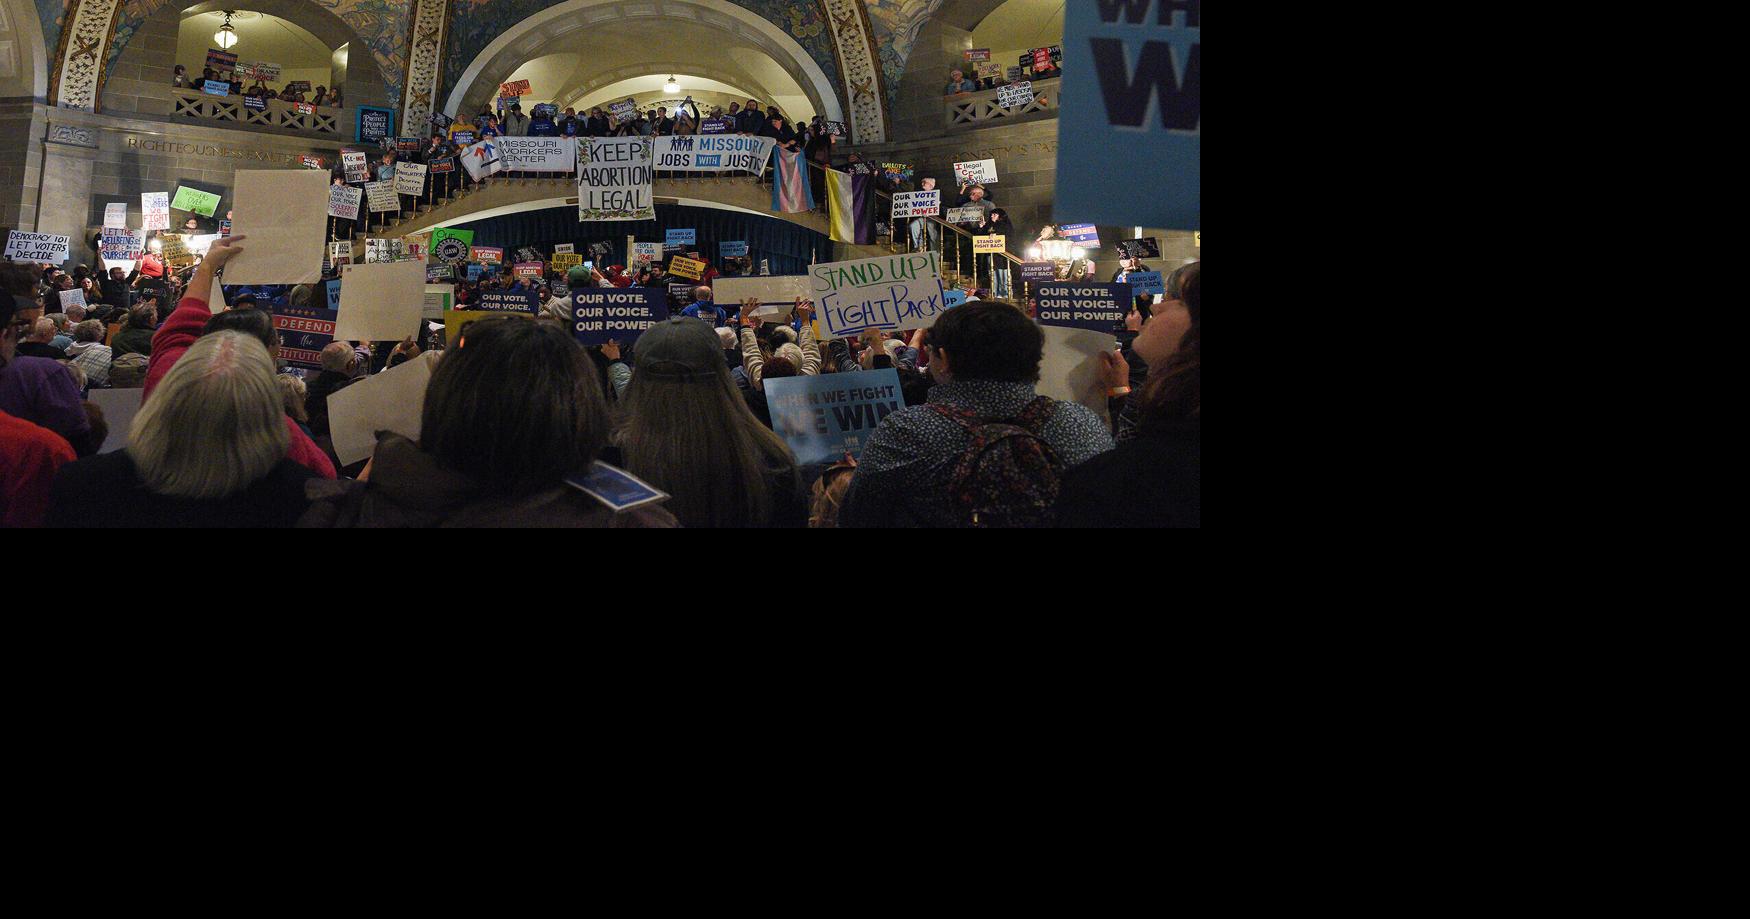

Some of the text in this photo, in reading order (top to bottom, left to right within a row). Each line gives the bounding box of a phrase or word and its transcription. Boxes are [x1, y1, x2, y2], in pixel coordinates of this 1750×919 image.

[700, 138, 764, 154] MISSOURI
[590, 142, 642, 162] KEEP
[658, 154, 765, 170] JOBS WITH JUSTIC
[579, 166, 652, 187] ABORTION
[590, 190, 647, 210] LEGAL
[912, 207, 938, 215] POWER
[144, 214, 168, 222] FIGHT
[10, 232, 51, 241] DEMOCRACY
[120, 228, 133, 236] THE
[9, 241, 68, 252] LET VOTERS
[16, 251, 53, 260] DECIDE
[103, 251, 143, 260] SUPREME LAW
[890, 253, 936, 280] UP!
[1040, 288, 1068, 296] OUR
[576, 294, 647, 304] OUR VOTE.
[888, 279, 946, 323] BACK!
[1040, 300, 1119, 309] OUR VOICE.
[576, 307, 652, 317] OUR VOICE.
[1041, 312, 1123, 320] OUR POWER
[281, 319, 331, 332] DEFEND
[576, 322, 602, 331] OUR
[823, 390, 846, 404] WE
[850, 386, 894, 400] FIGHT
